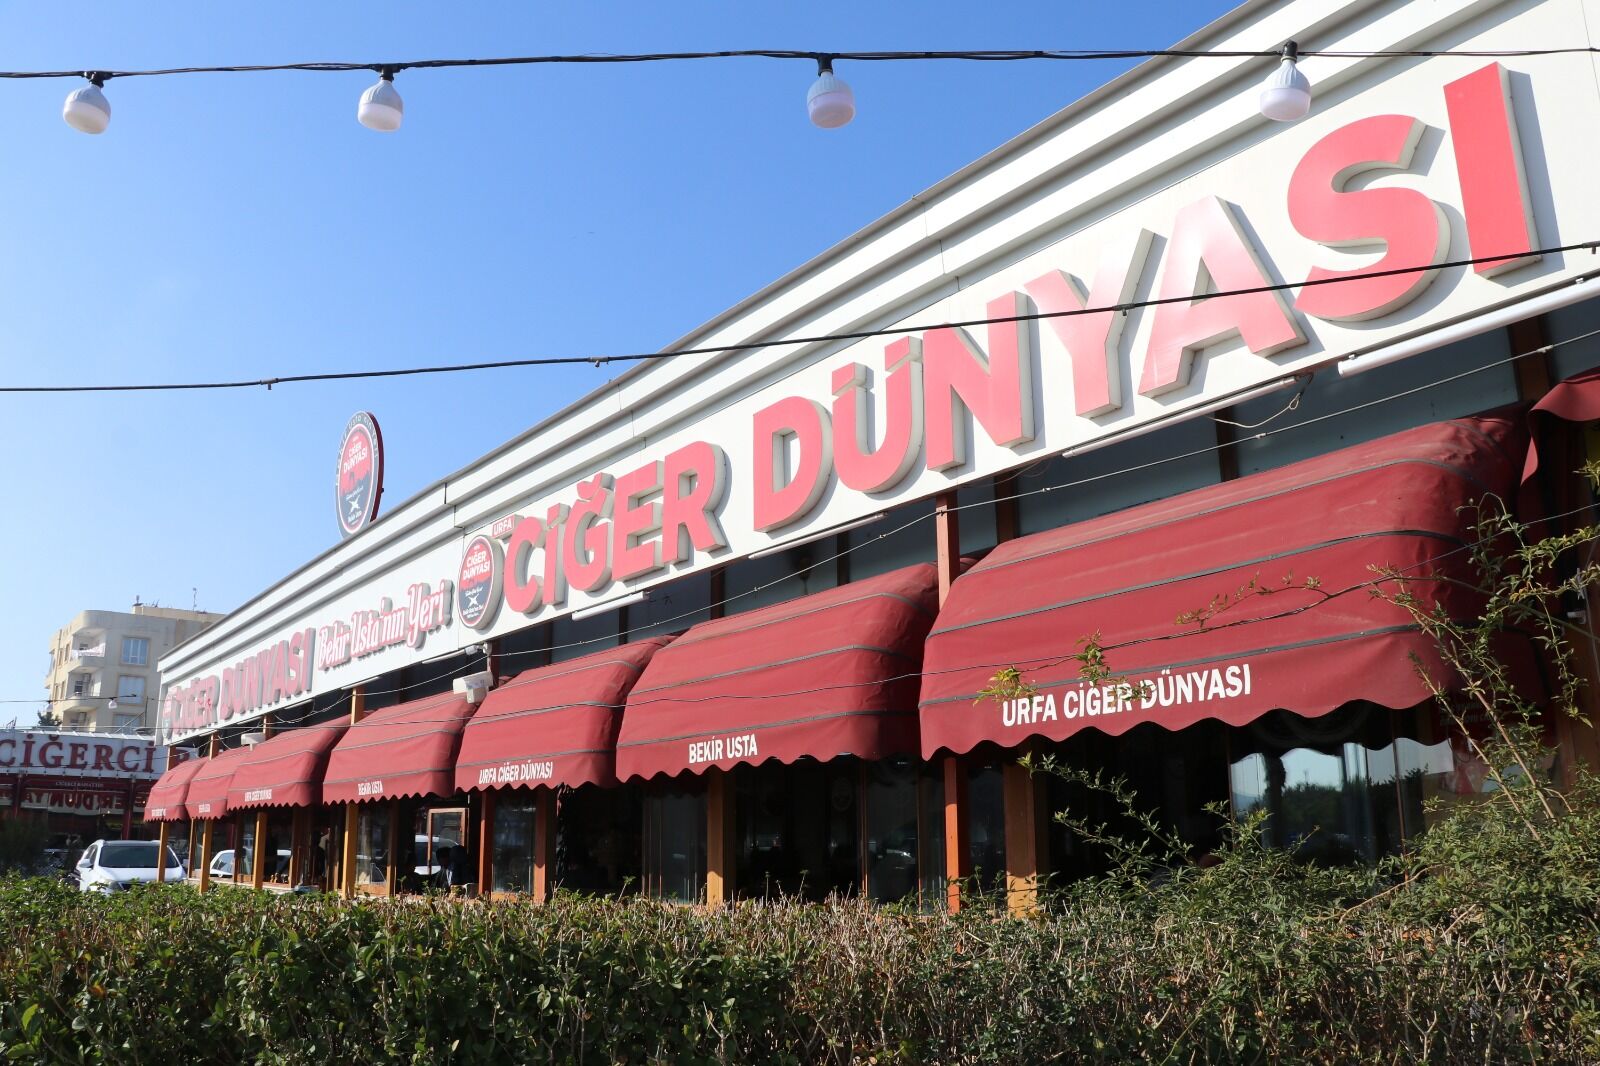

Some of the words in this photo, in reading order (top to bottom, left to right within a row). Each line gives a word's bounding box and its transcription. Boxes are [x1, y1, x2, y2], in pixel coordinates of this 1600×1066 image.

[503, 440, 727, 614] CİĞER
[753, 61, 1539, 533] DÜNYASI
[493, 517, 513, 536] URFA
[463, 560, 491, 581] DÜNYASI
[319, 621, 351, 669] Bekir
[406, 579, 450, 648] Yeri
[1002, 693, 1058, 727] URFA
[1063, 680, 1133, 718] CİĞER
[1140, 663, 1252, 710] DÜNYASI
[688, 735, 723, 764] BEKİR
[726, 733, 758, 759] USTA
[478, 767, 497, 785] URFA
[497, 761, 520, 783] CİĞER
[520, 760, 554, 781] DÜNYASI
